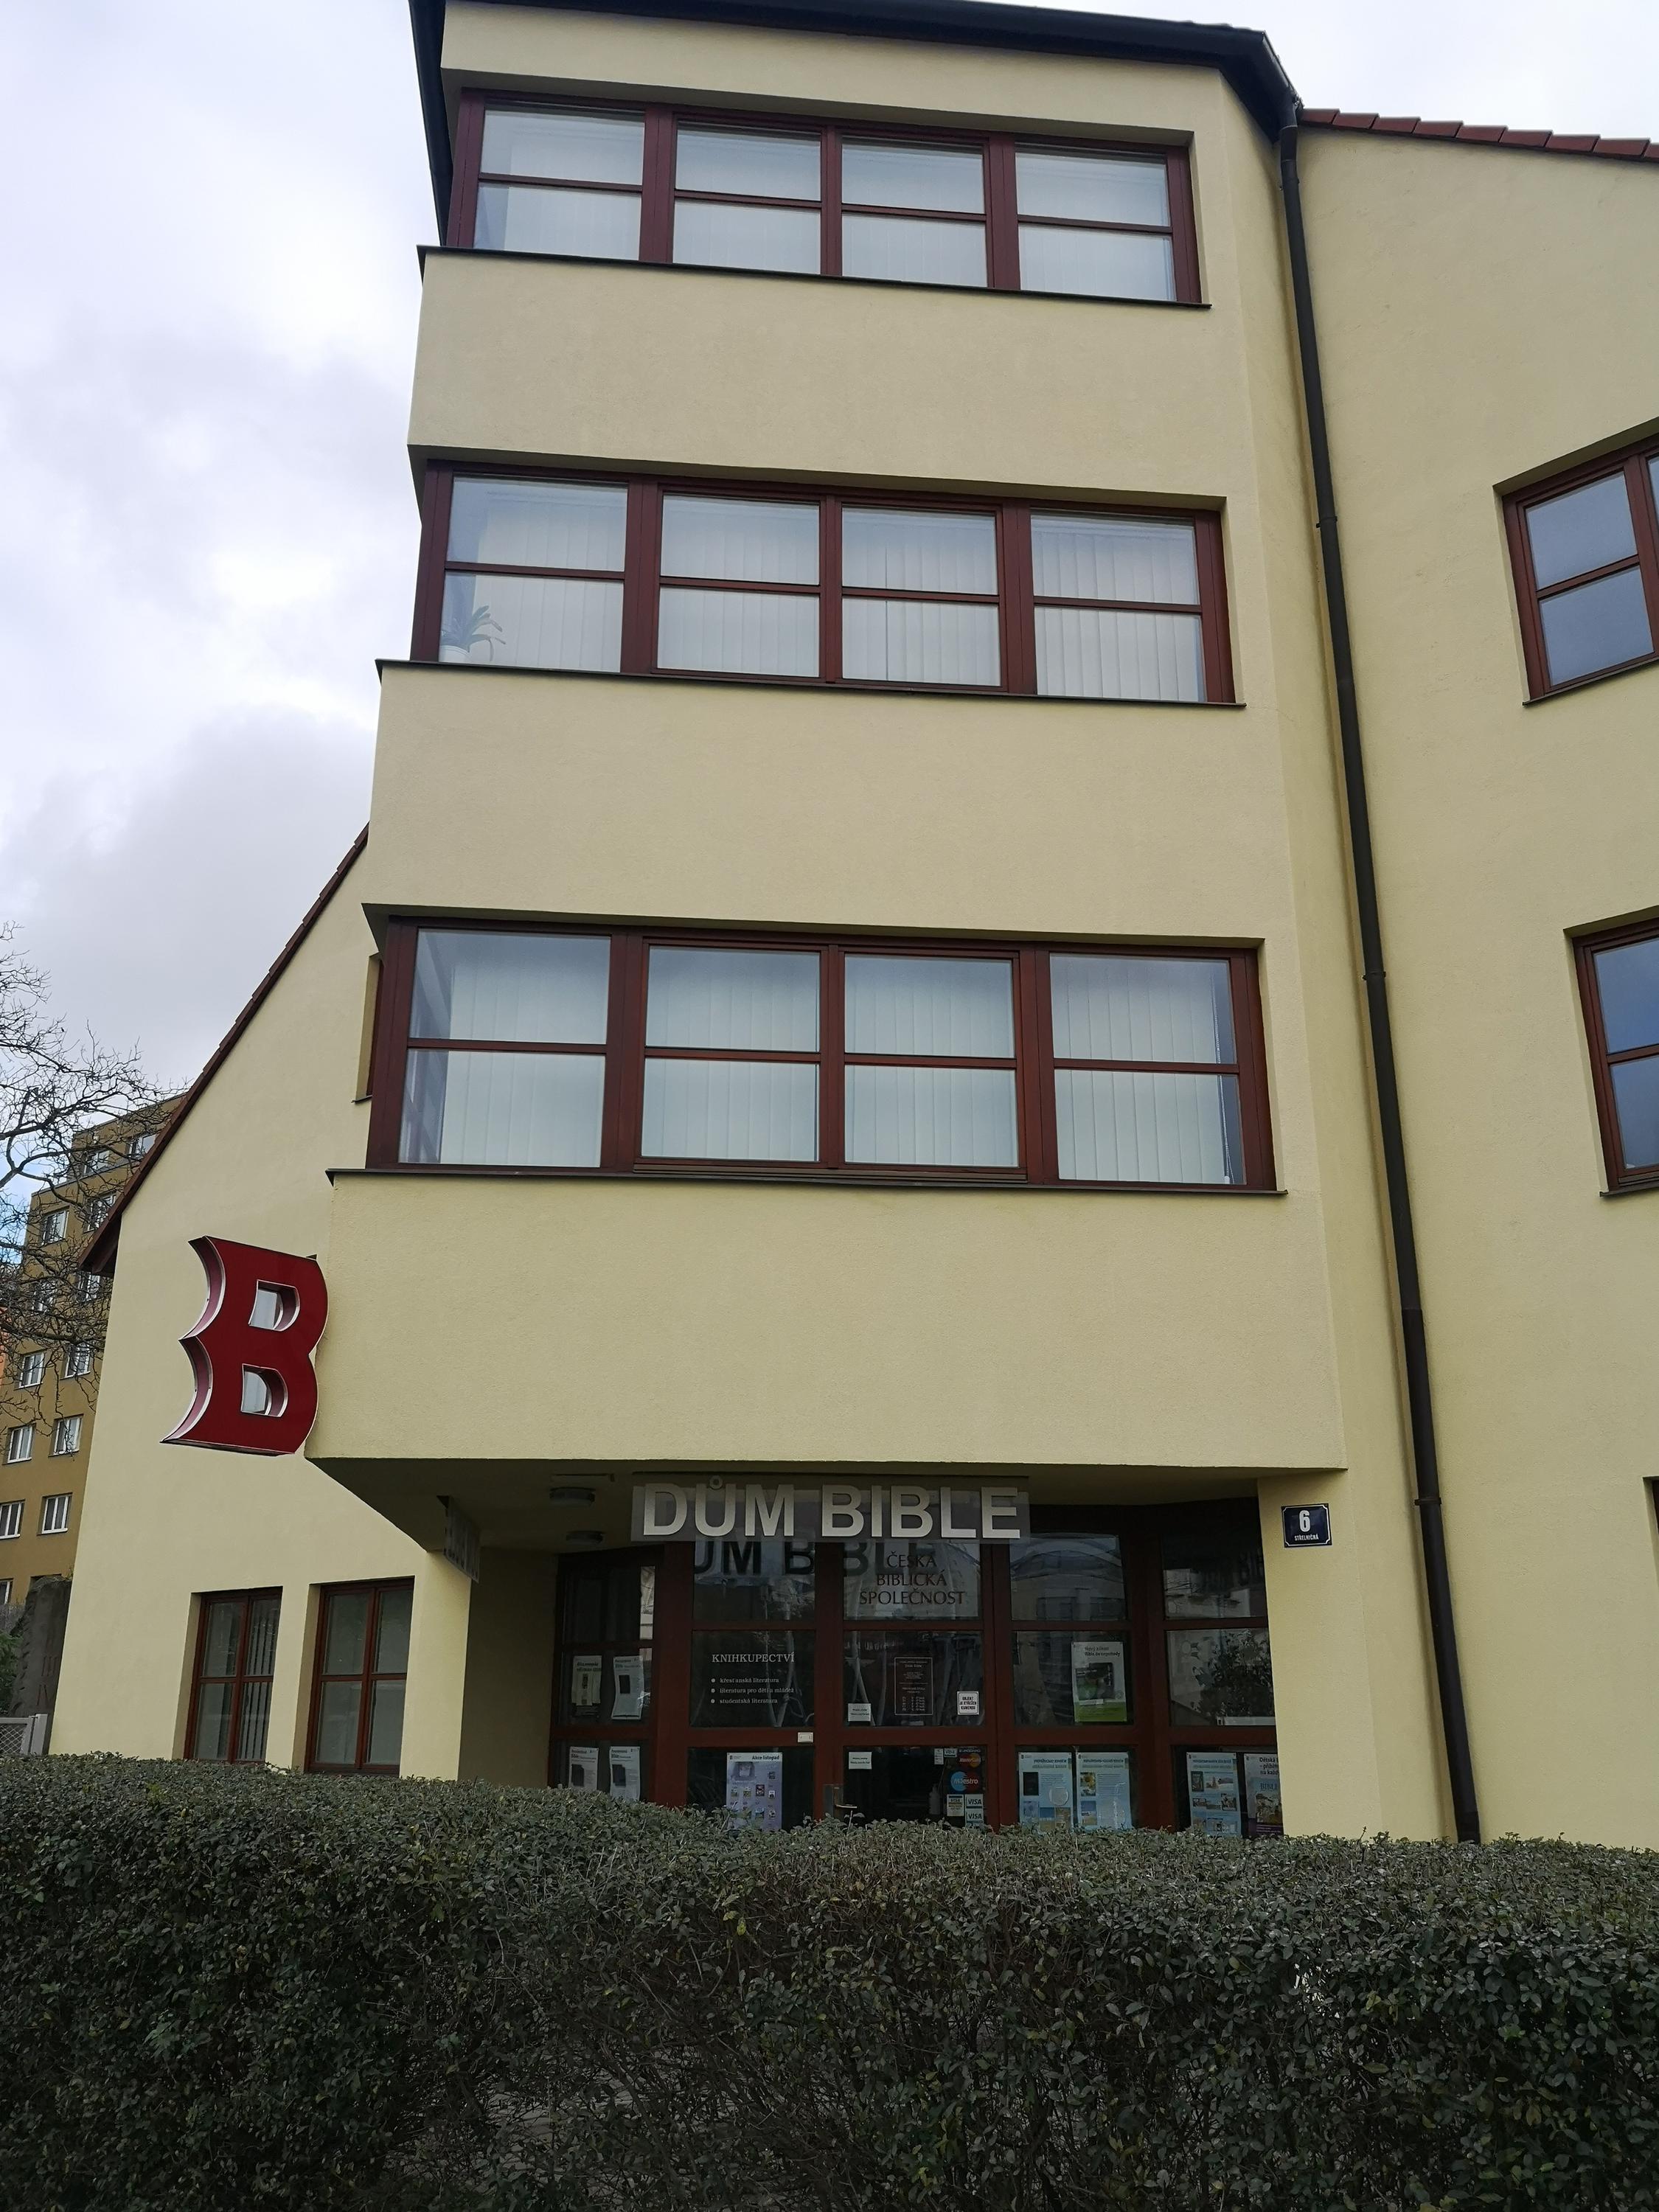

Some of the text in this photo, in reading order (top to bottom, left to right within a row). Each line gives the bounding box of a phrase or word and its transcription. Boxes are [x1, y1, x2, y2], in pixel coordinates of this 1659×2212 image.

[160, 1236, 329, 1458] B
[643, 1475, 1021, 1539] DŮM BIBLE
[1299, 1509, 1311, 1532] 6
[877, 1569, 947, 1586] BIBLICKÁ
[860, 1587, 966, 1604] SPOLEČNOST
[712, 1652, 795, 1663] KNIHKUPECTVÍ
